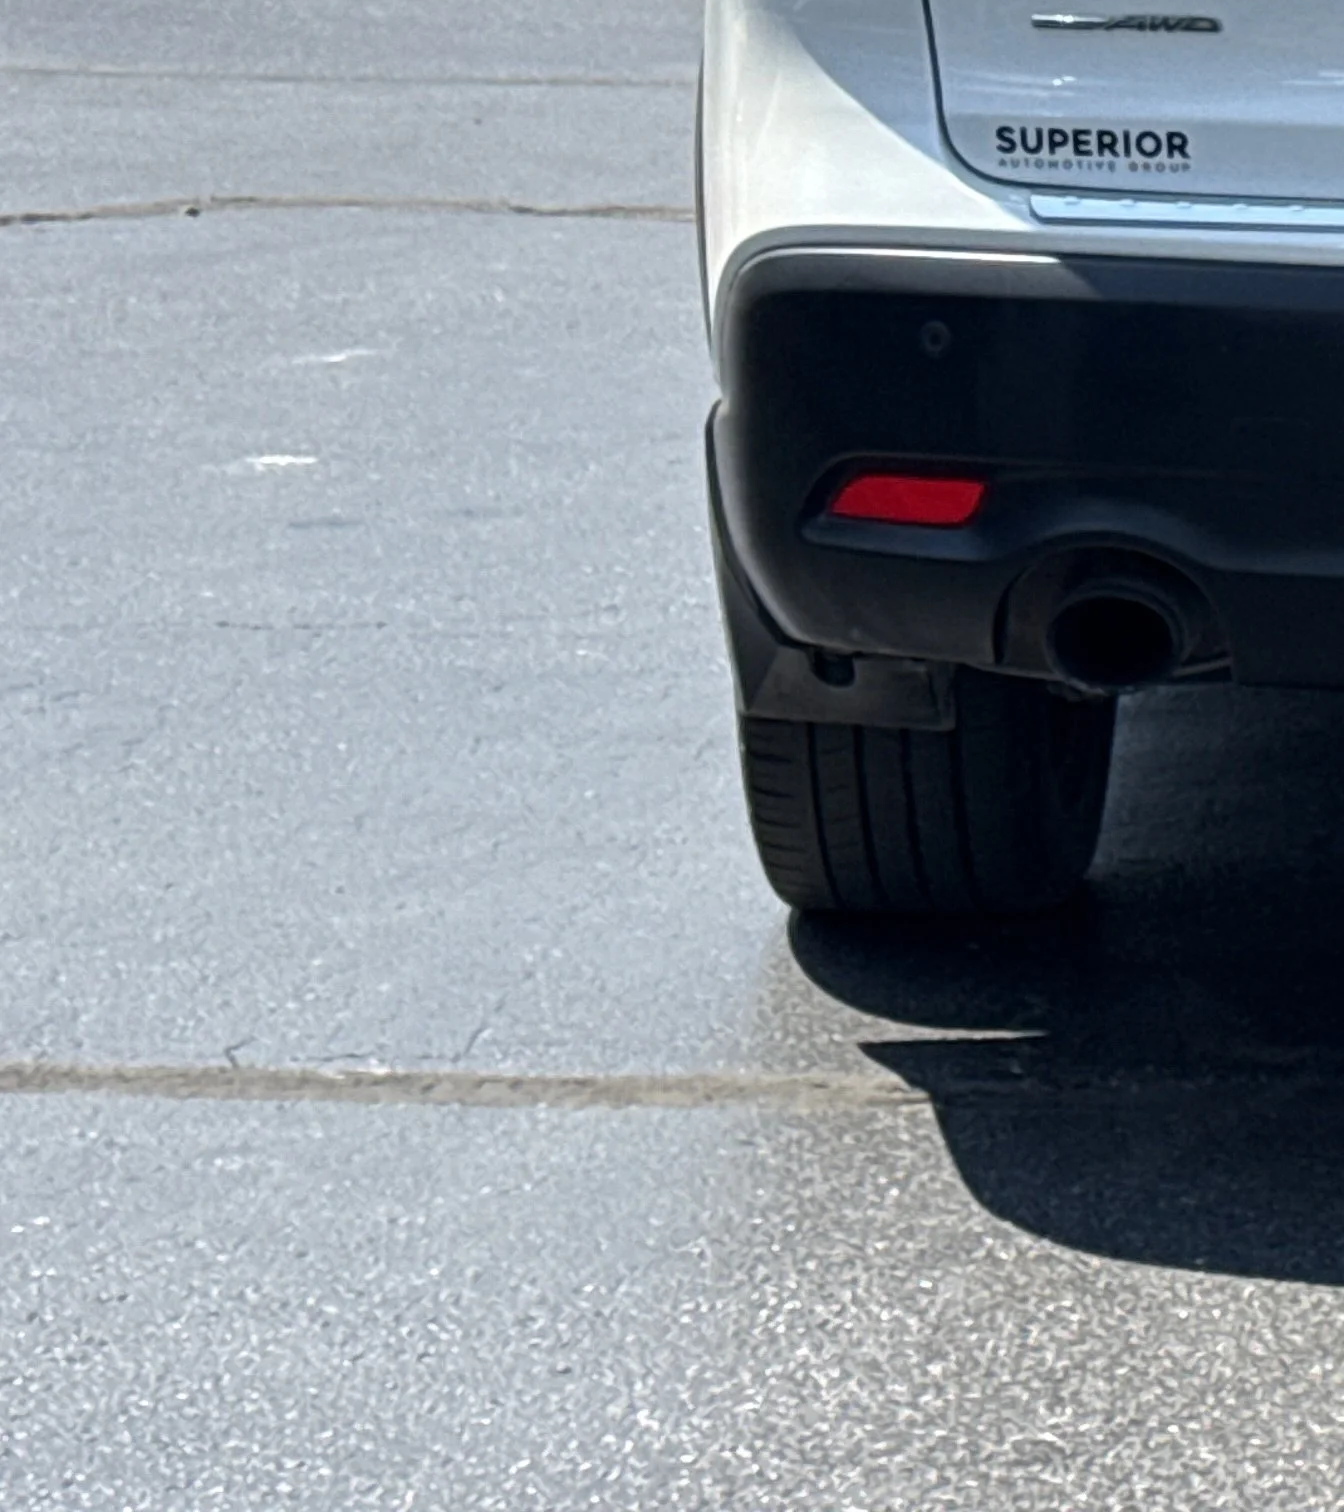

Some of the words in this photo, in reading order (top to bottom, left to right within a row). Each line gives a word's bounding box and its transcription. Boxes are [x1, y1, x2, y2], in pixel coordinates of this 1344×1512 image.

[995, 125, 1192, 160] SUPERIOR
[998, 156, 1117, 173] AUTOMOTIVE
[1128, 159, 1192, 174] GROUP
